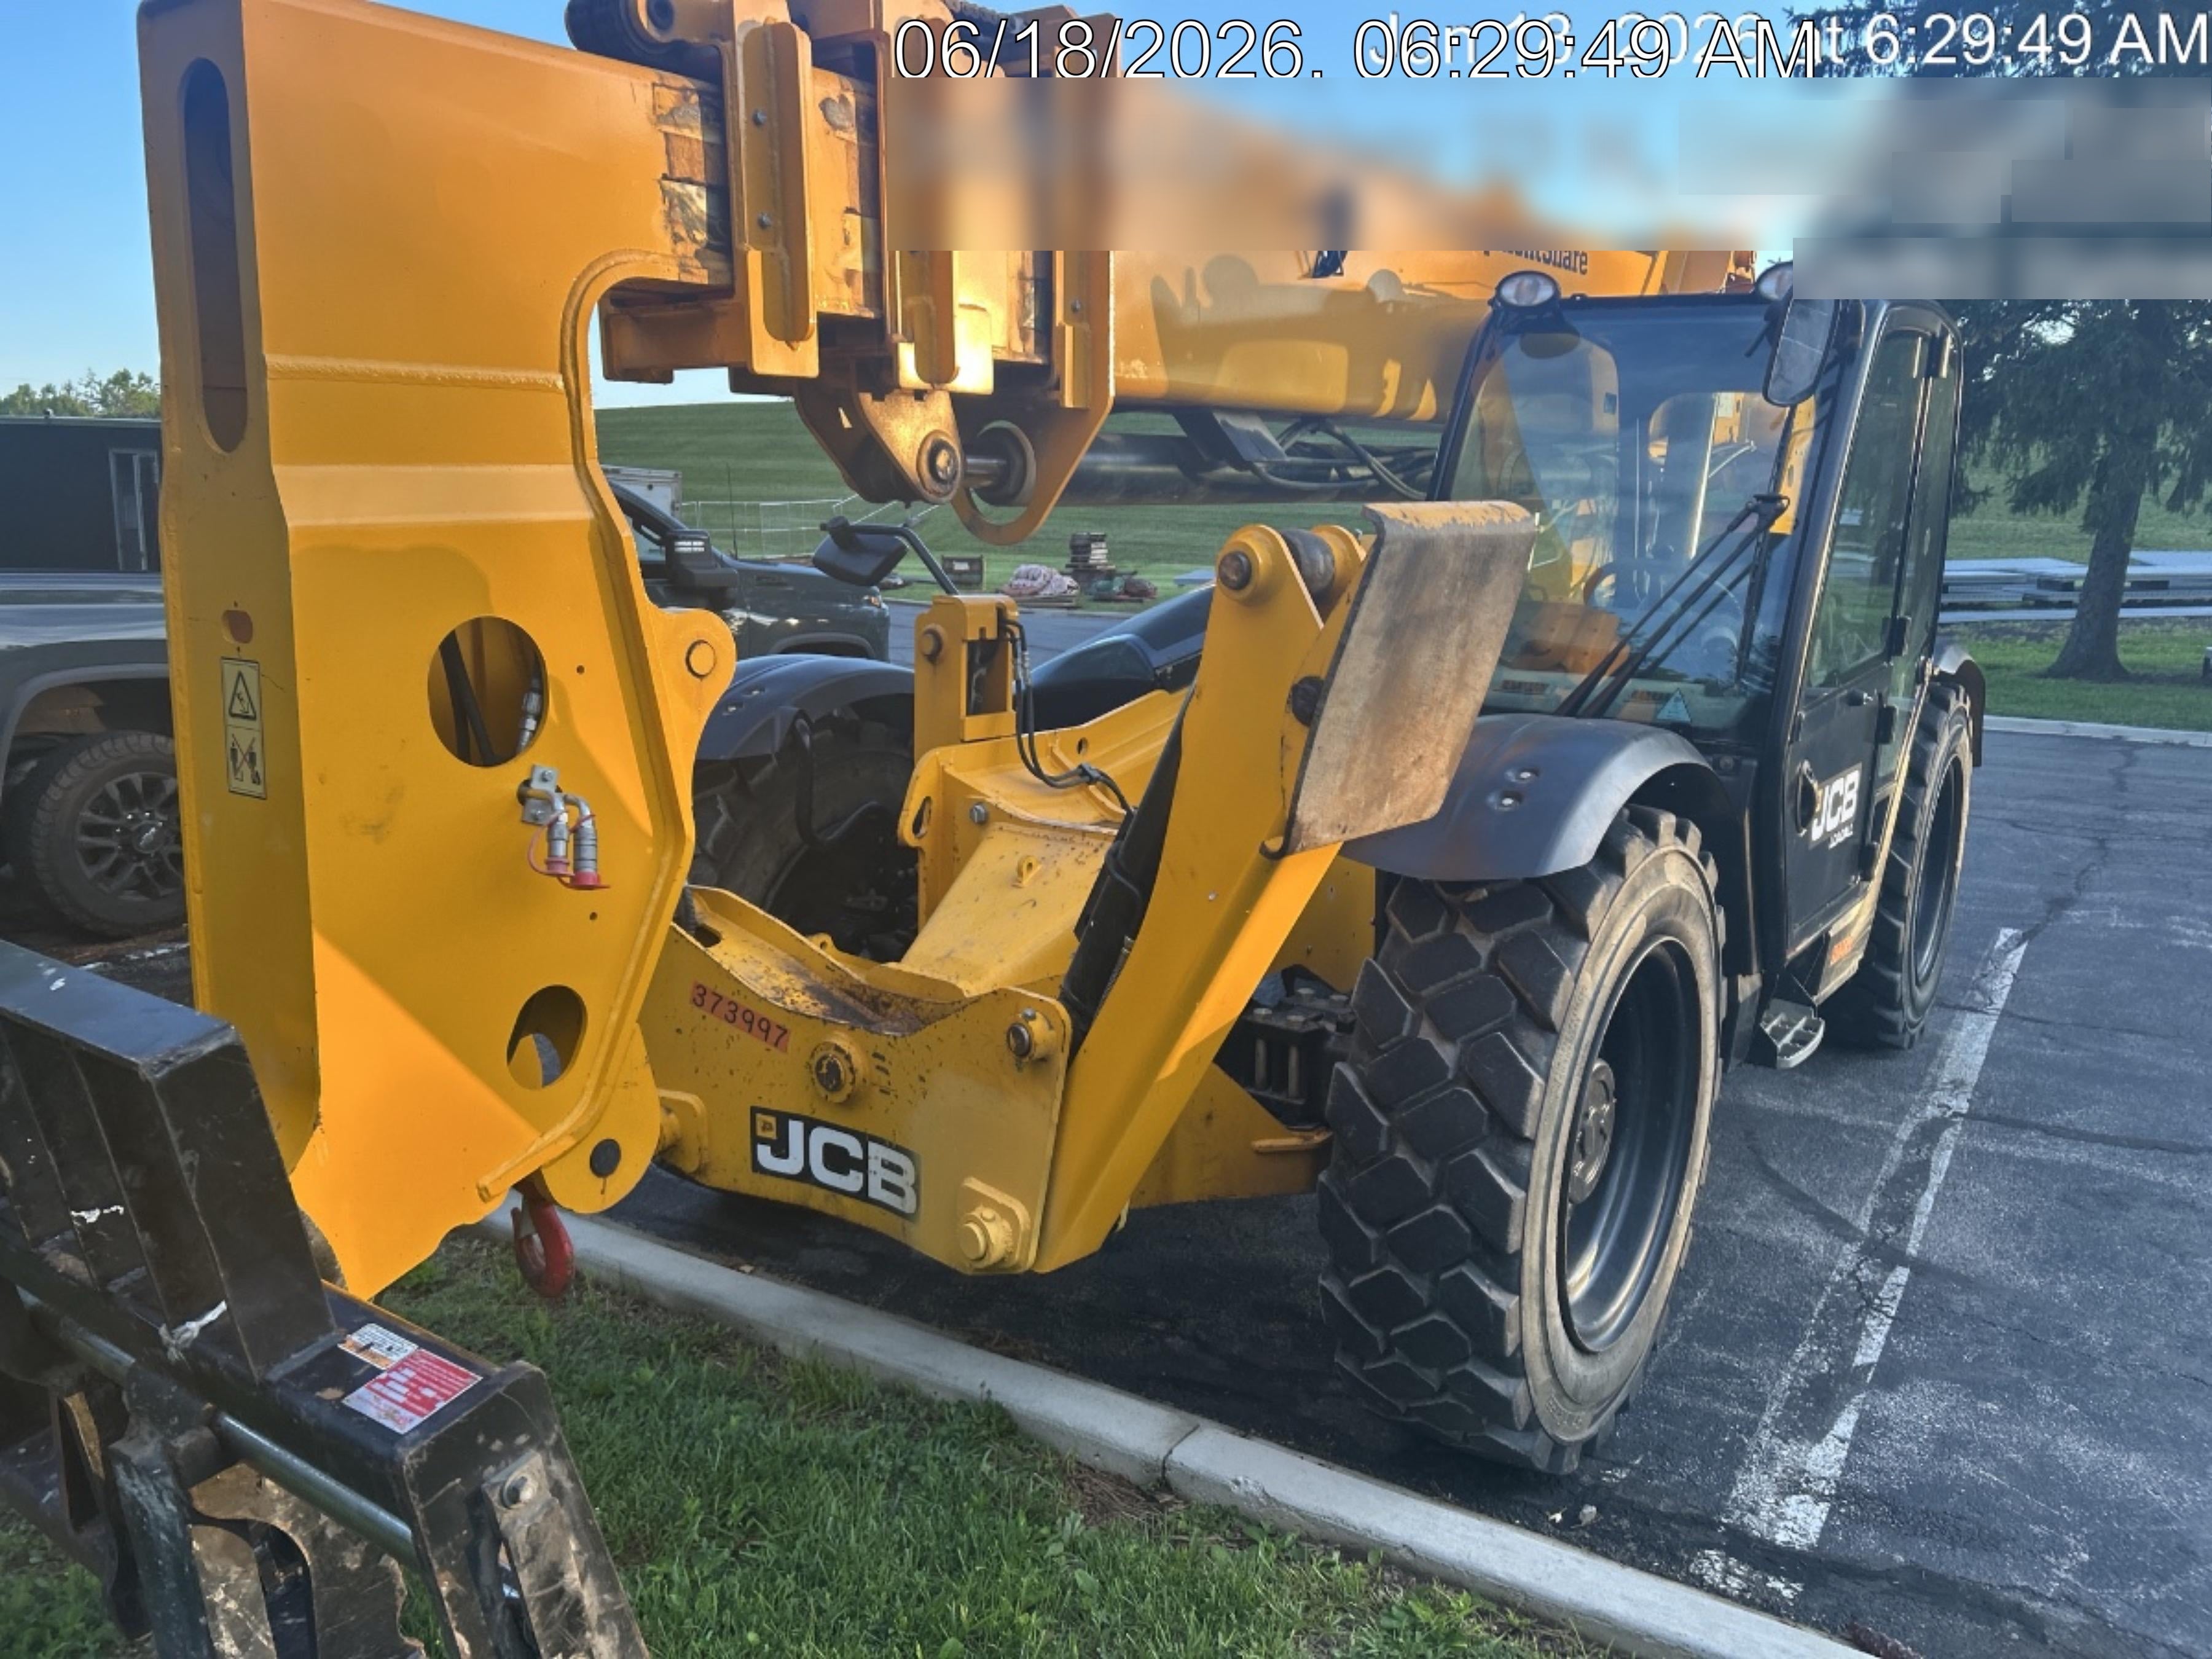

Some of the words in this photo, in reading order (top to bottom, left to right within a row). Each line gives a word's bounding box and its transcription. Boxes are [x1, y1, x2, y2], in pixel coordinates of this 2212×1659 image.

[1811, 770, 1860, 841] JCB
[692, 984, 788, 1048] 373997
[756, 1119, 917, 1214] JCB
